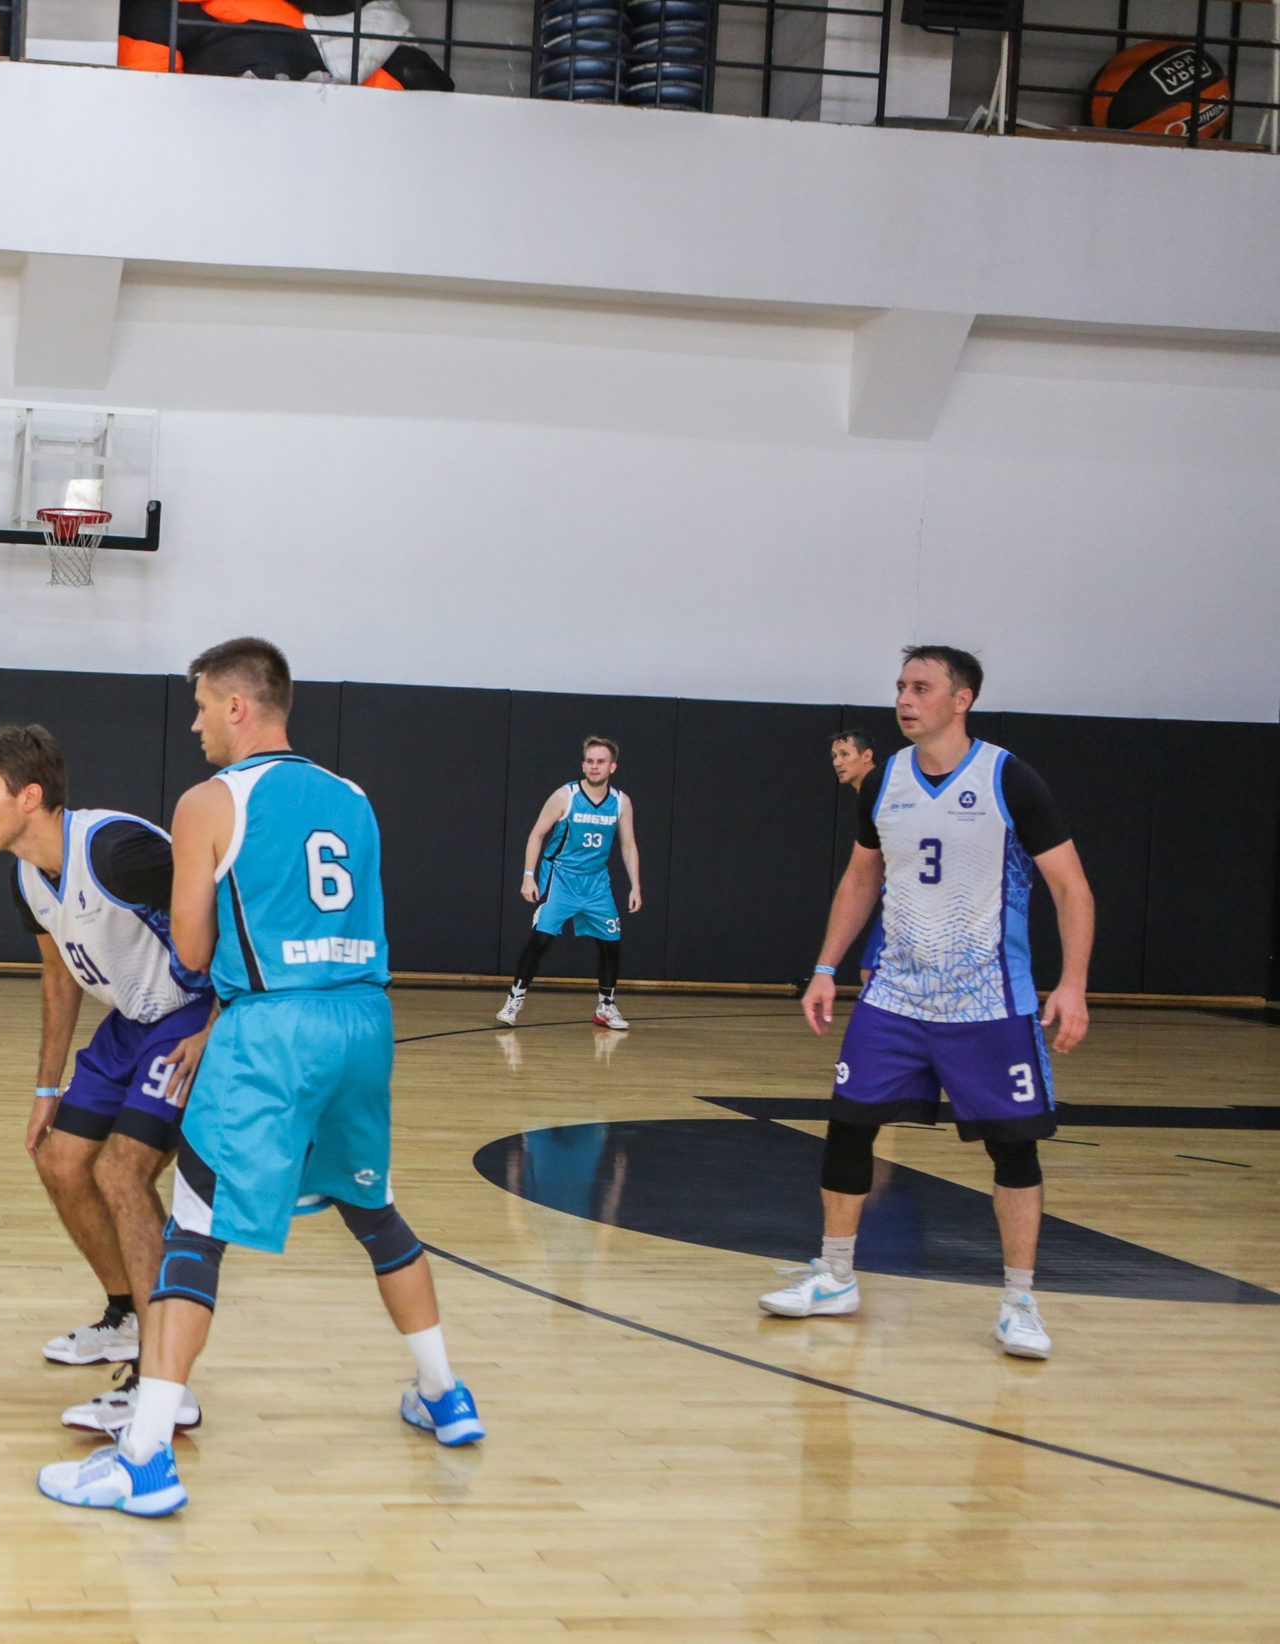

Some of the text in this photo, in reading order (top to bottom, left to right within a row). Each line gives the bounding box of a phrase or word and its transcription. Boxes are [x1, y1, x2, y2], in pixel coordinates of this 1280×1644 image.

[572, 812, 617, 826] СИБУР
[582, 832, 603, 848] 33
[304, 829, 355, 914] 6
[918, 837, 943, 885] 3
[65, 941, 111, 986] 91
[282, 936, 376, 965] СИБУР
[1008, 1062, 1036, 1103] 3
